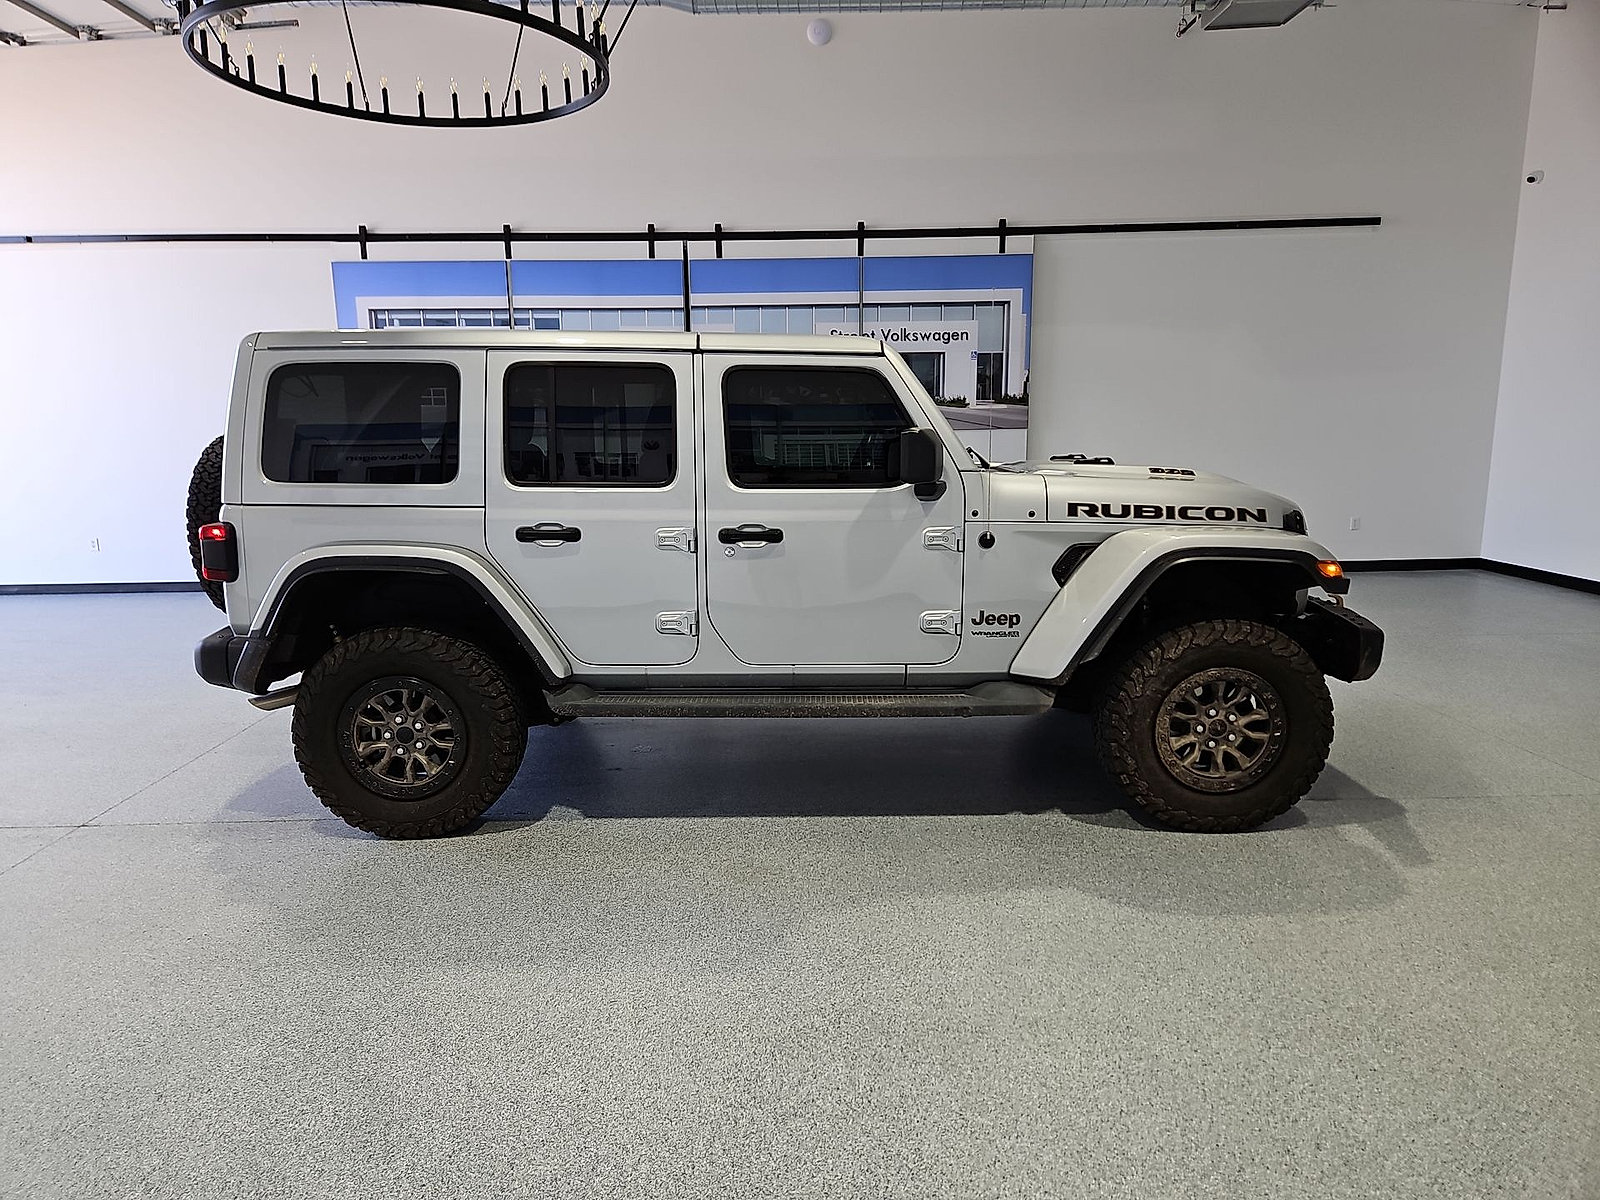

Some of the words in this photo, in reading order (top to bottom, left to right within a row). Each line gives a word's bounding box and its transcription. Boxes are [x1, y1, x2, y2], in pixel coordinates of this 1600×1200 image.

[880, 328, 969, 344] Volkswagen
[1066, 502, 1268, 523] RUBICON
[970, 609, 1021, 629] Jeep
